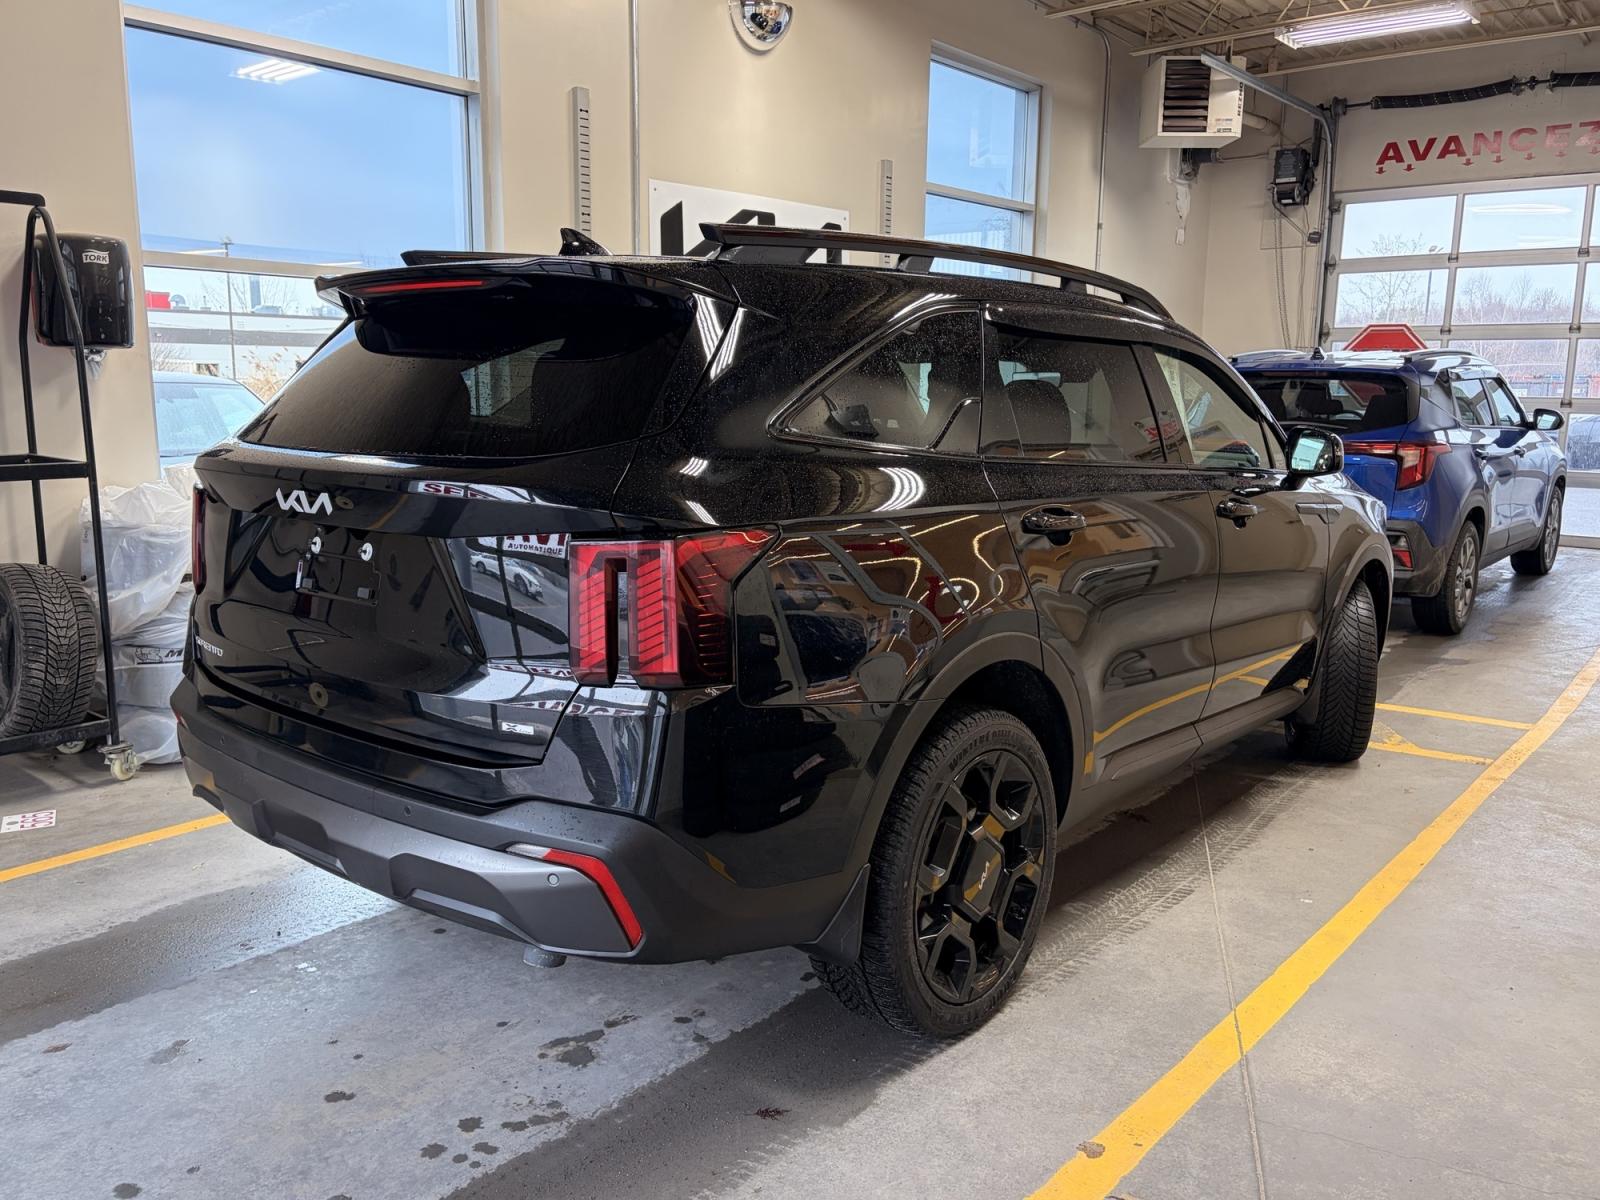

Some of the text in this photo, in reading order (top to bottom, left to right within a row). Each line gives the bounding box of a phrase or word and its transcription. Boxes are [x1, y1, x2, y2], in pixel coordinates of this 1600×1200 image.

[83, 254, 108, 263] TORK
[276, 487, 333, 516] KIA
[507, 542, 564, 556] AUTOMATIQUE
